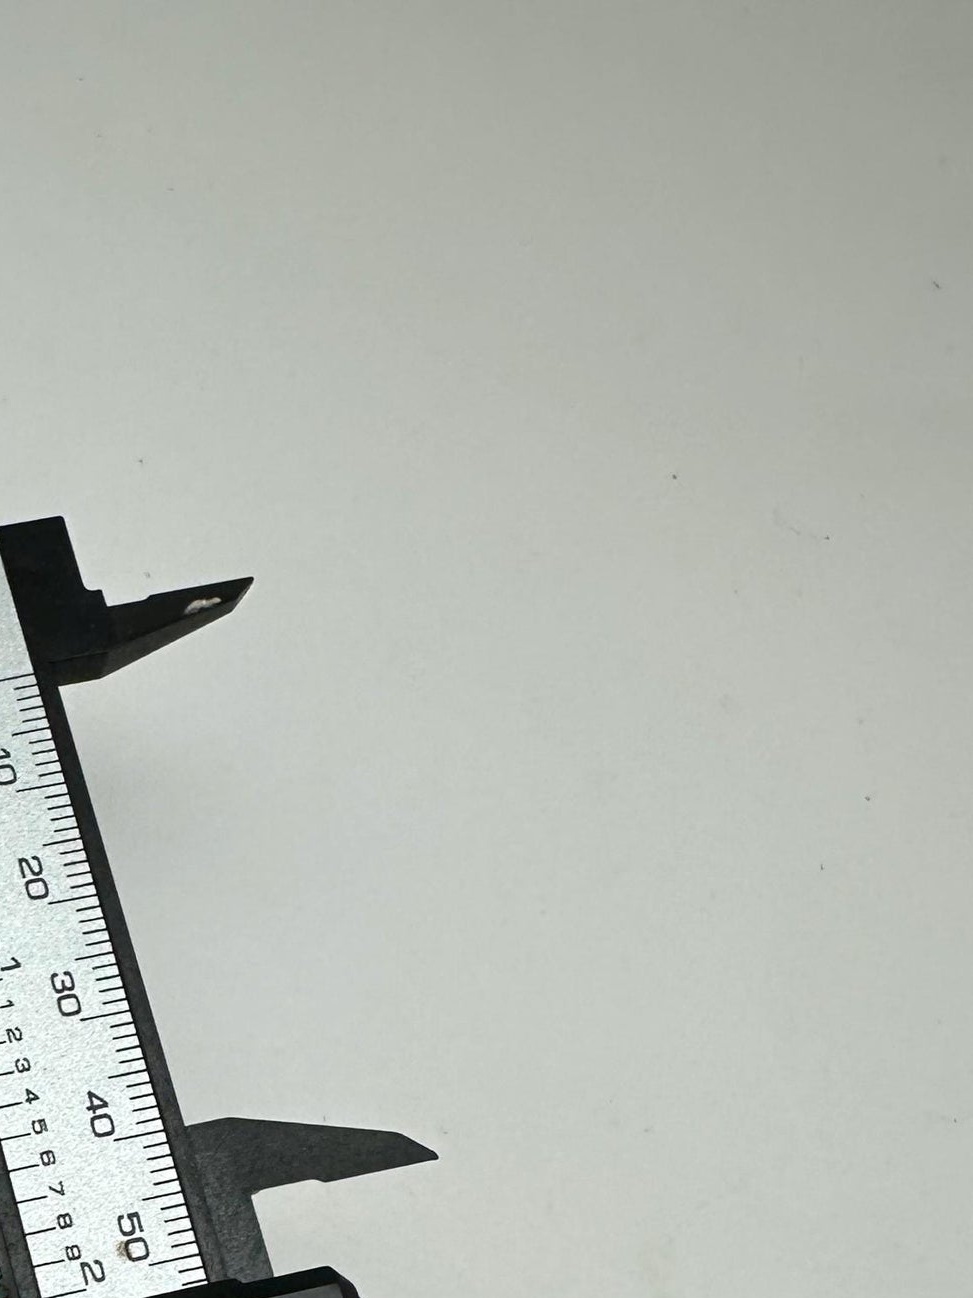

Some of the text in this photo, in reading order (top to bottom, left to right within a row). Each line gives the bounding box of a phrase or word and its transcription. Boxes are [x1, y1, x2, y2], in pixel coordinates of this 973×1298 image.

[18, 856, 49, 900] 20
[0, 957, 21, 972] 1
[50, 971, 82, 1017] 30
[0, 999, 15, 1009] 1
[6, 1027, 23, 1042] 2
[15, 1058, 31, 1073] 3
[25, 1088, 40, 1105] 4
[86, 1090, 115, 1138] 40
[32, 1118, 48, 1135] 5
[40, 1150, 56, 1166] 6
[49, 1181, 65, 1196] 7
[57, 1212, 73, 1230] 8
[117, 1211, 150, 1262] 50
[80, 1259, 106, 1286] 2
